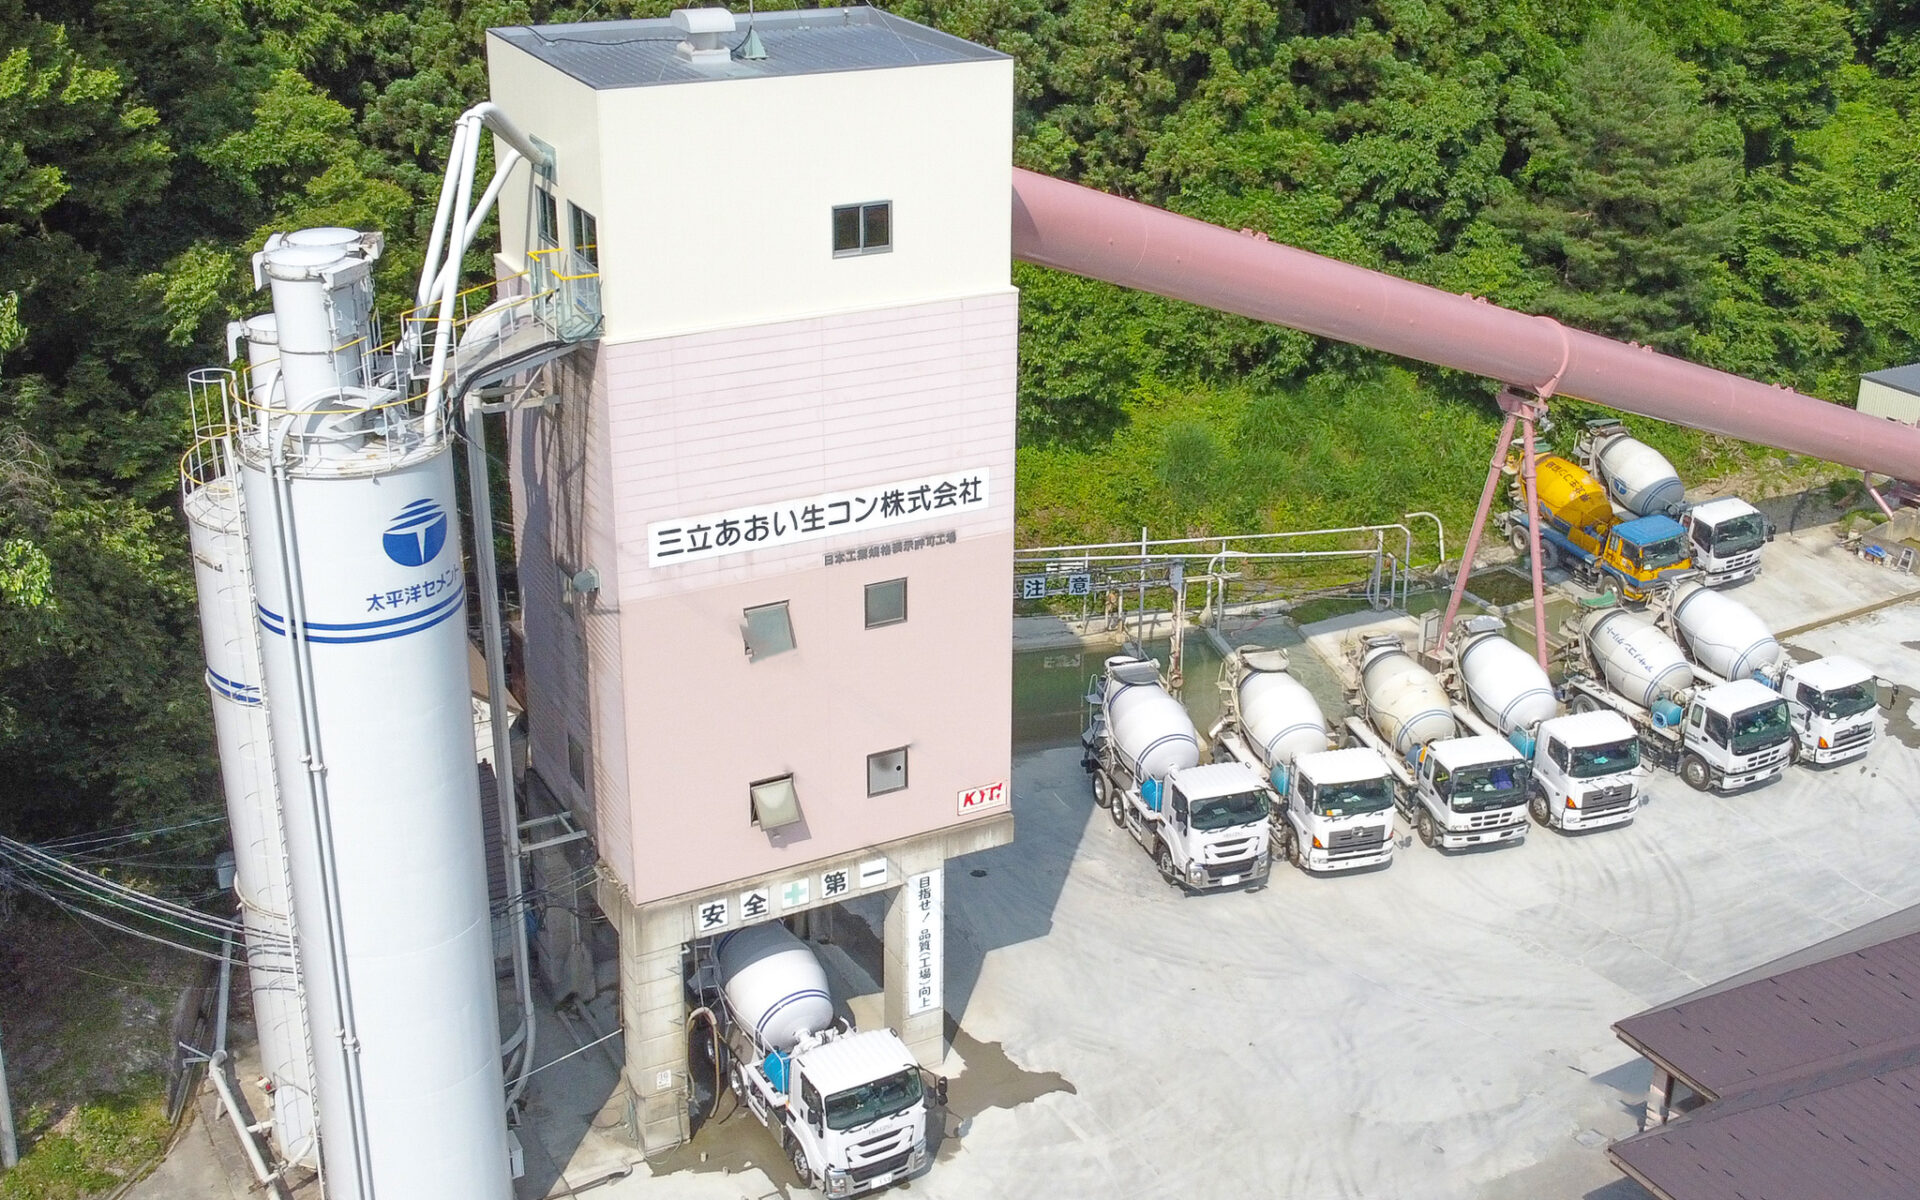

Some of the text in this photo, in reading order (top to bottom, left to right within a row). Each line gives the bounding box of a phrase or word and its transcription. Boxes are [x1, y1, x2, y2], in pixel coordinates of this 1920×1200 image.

[657, 476, 982, 557] 三立あおい生コン株式会社
[366, 564, 459, 612] 太平洋セメント
[1025, 577, 1089, 597] 注意
[701, 869, 886, 928] 安全第一
